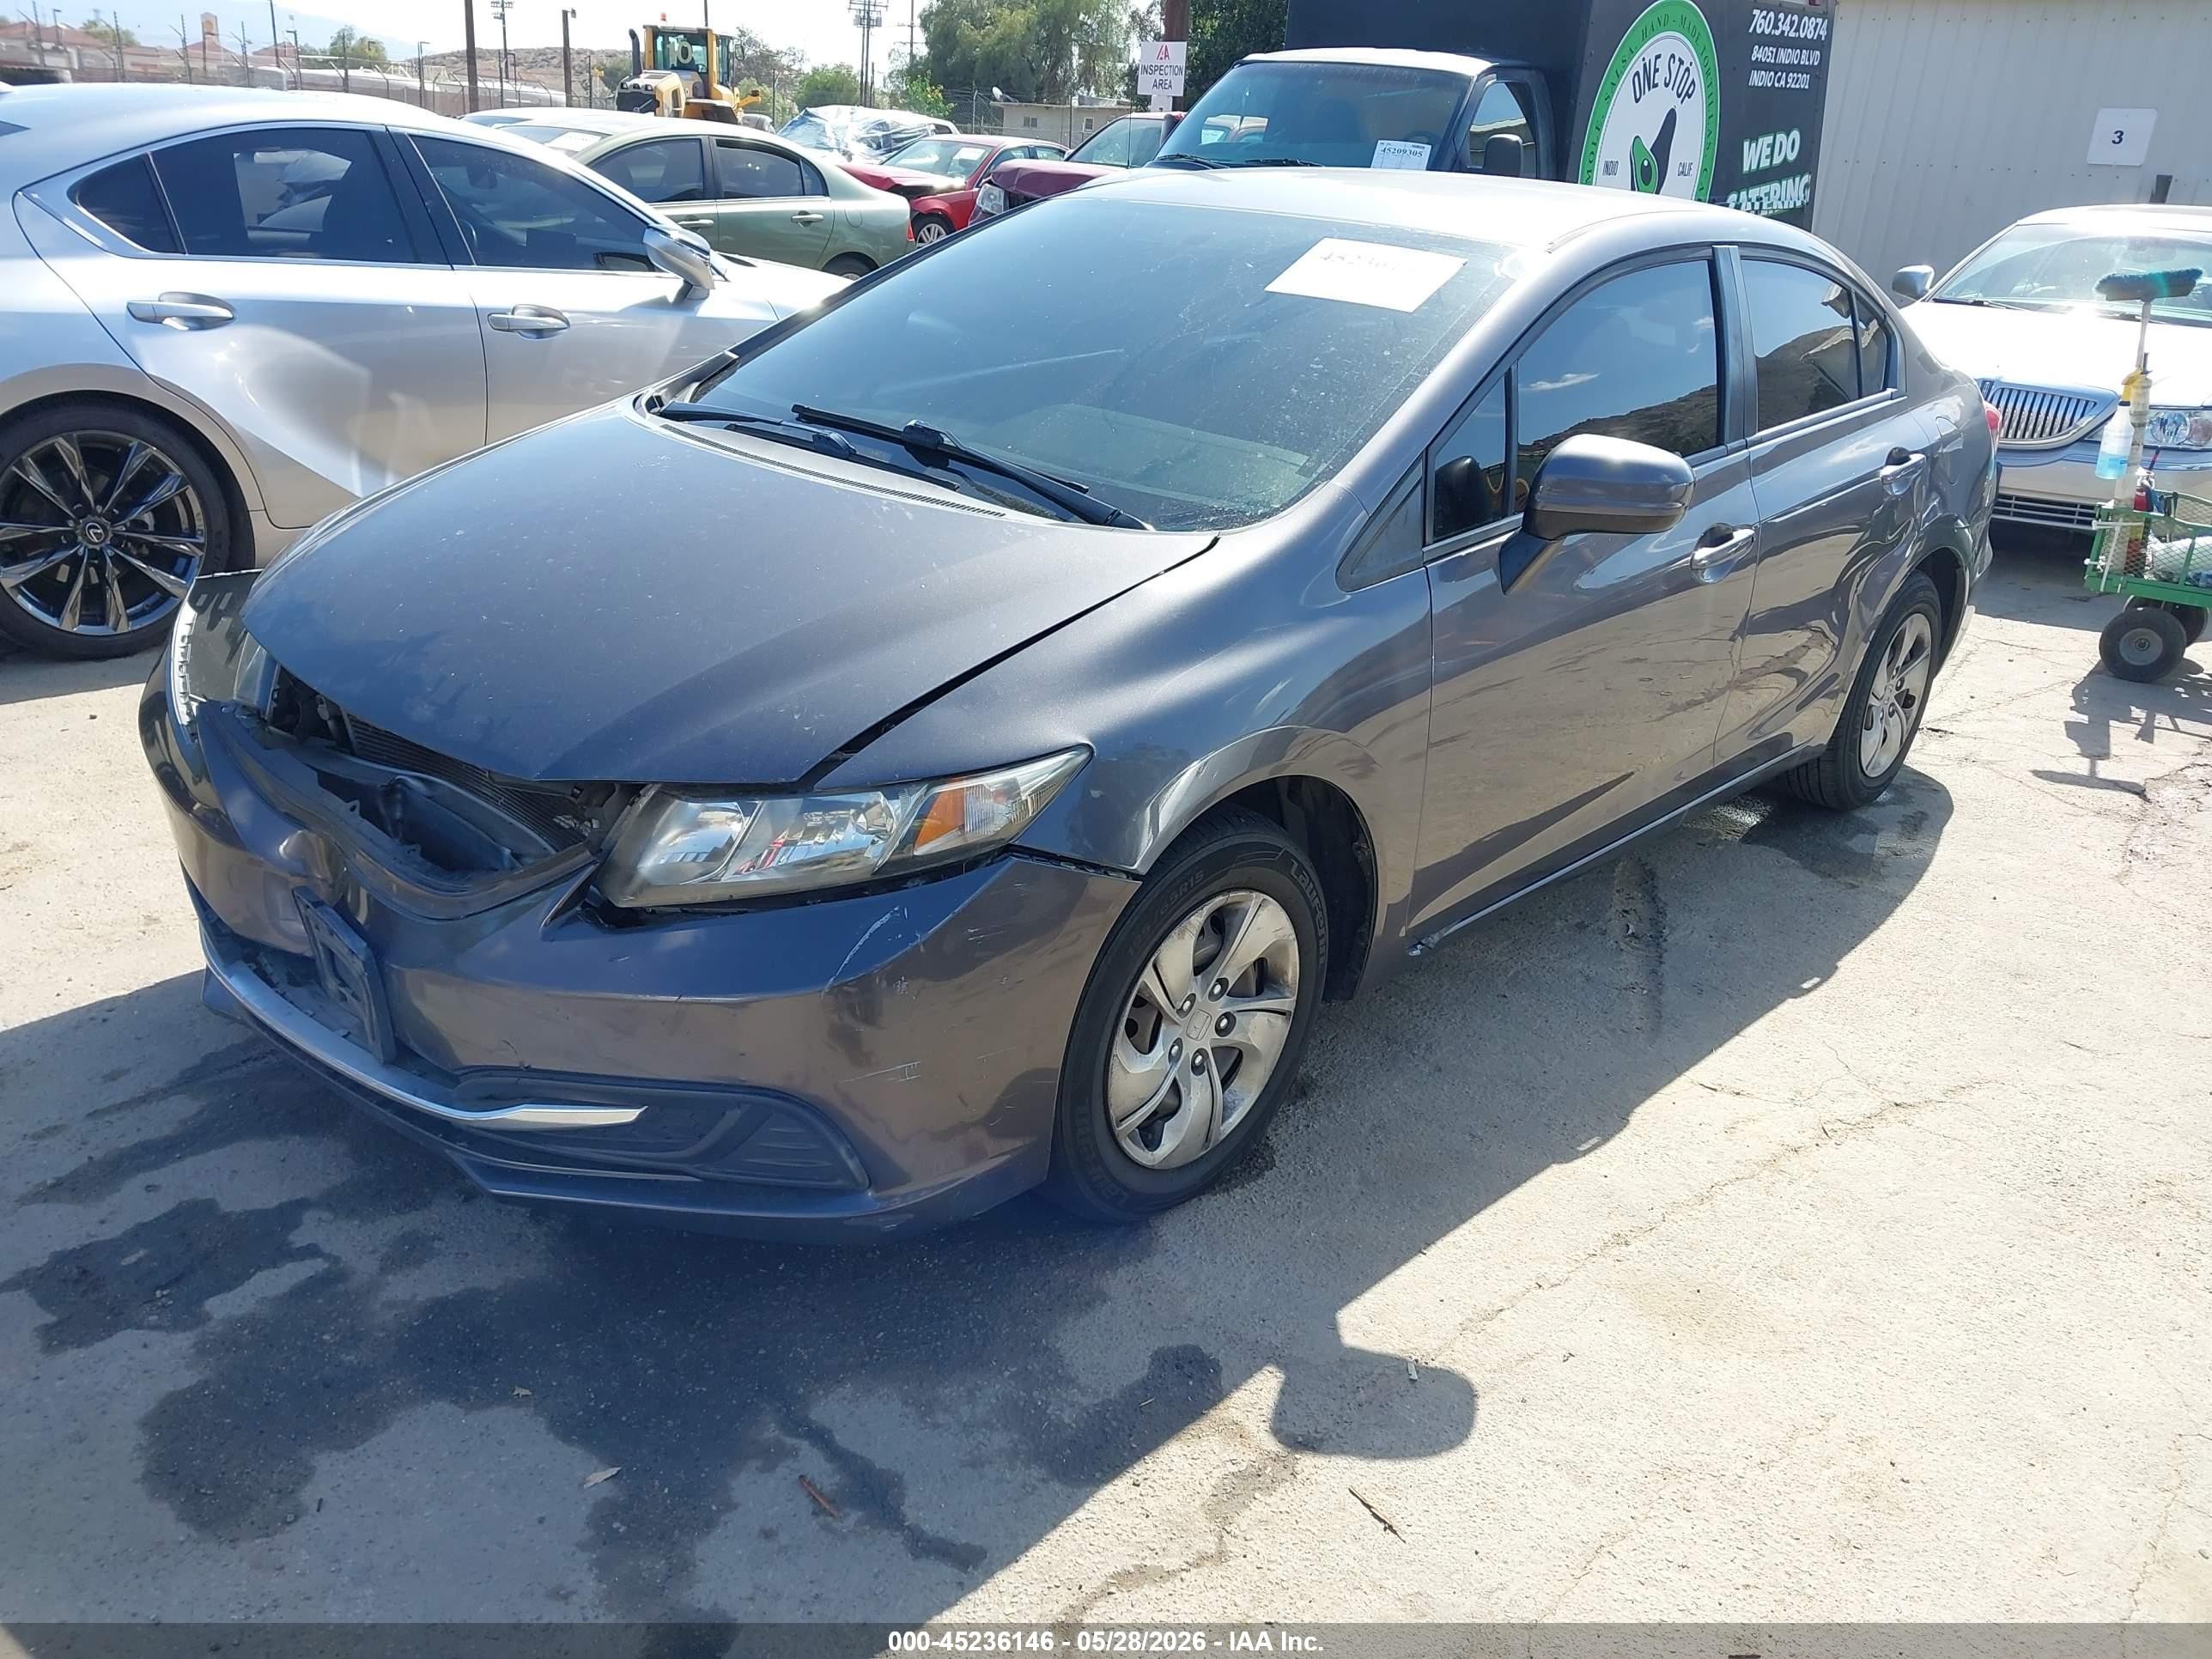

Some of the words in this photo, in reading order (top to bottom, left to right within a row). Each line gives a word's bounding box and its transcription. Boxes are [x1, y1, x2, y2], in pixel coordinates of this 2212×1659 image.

[1748, 9, 1828, 41] 760.342.0874
[1751, 45, 1777, 64] 84051
[1776, 47, 1801, 65] INDIO
[1800, 49, 1820, 66] BLVD
[1139, 64, 1183, 76] INSPECTION
[1152, 79, 1173, 90] AREA
[1632, 53, 1662, 104] ONE
[1663, 53, 1697, 105] STOP
[1748, 70, 1775, 87] INDIO
[1774, 71, 1787, 88] CA
[1786, 72, 1810, 89] 92201
[2112, 131, 2124, 144] 3
[1381, 147, 1423, 158] 45209305
[1742, 134, 1774, 173] WE
[1771, 129, 1801, 166] DO
[1602, 160, 1620, 176] INDIO
[1677, 161, 1693, 177] CALIF.
[1726, 173, 1812, 214] CATERING
